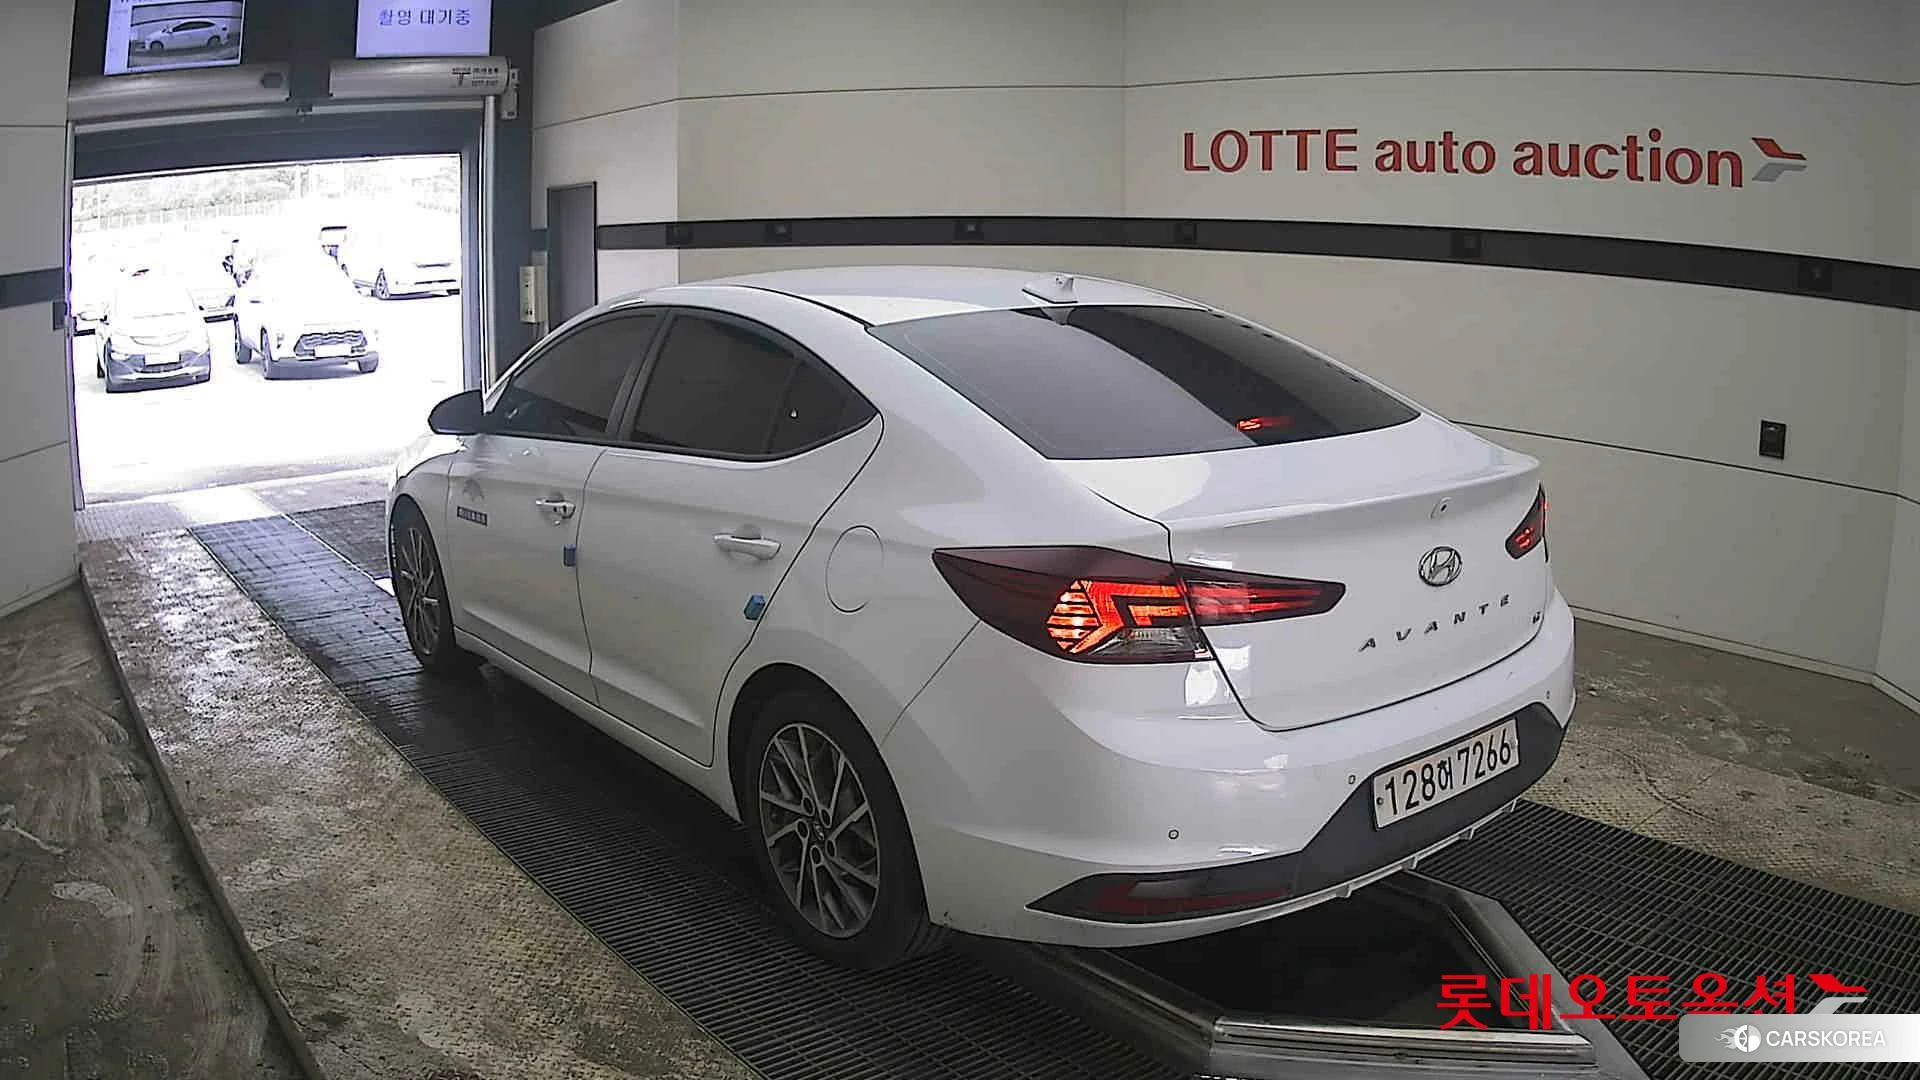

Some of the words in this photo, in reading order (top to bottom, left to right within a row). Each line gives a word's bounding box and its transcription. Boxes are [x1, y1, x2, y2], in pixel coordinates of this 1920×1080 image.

[420, 8, 471, 26] 대기중
[1184, 129, 1358, 173] LOTTE
[1376, 131, 1496, 173] auto
[1513, 128, 1744, 187] auction
[1358, 593, 1511, 652] AVANTE
